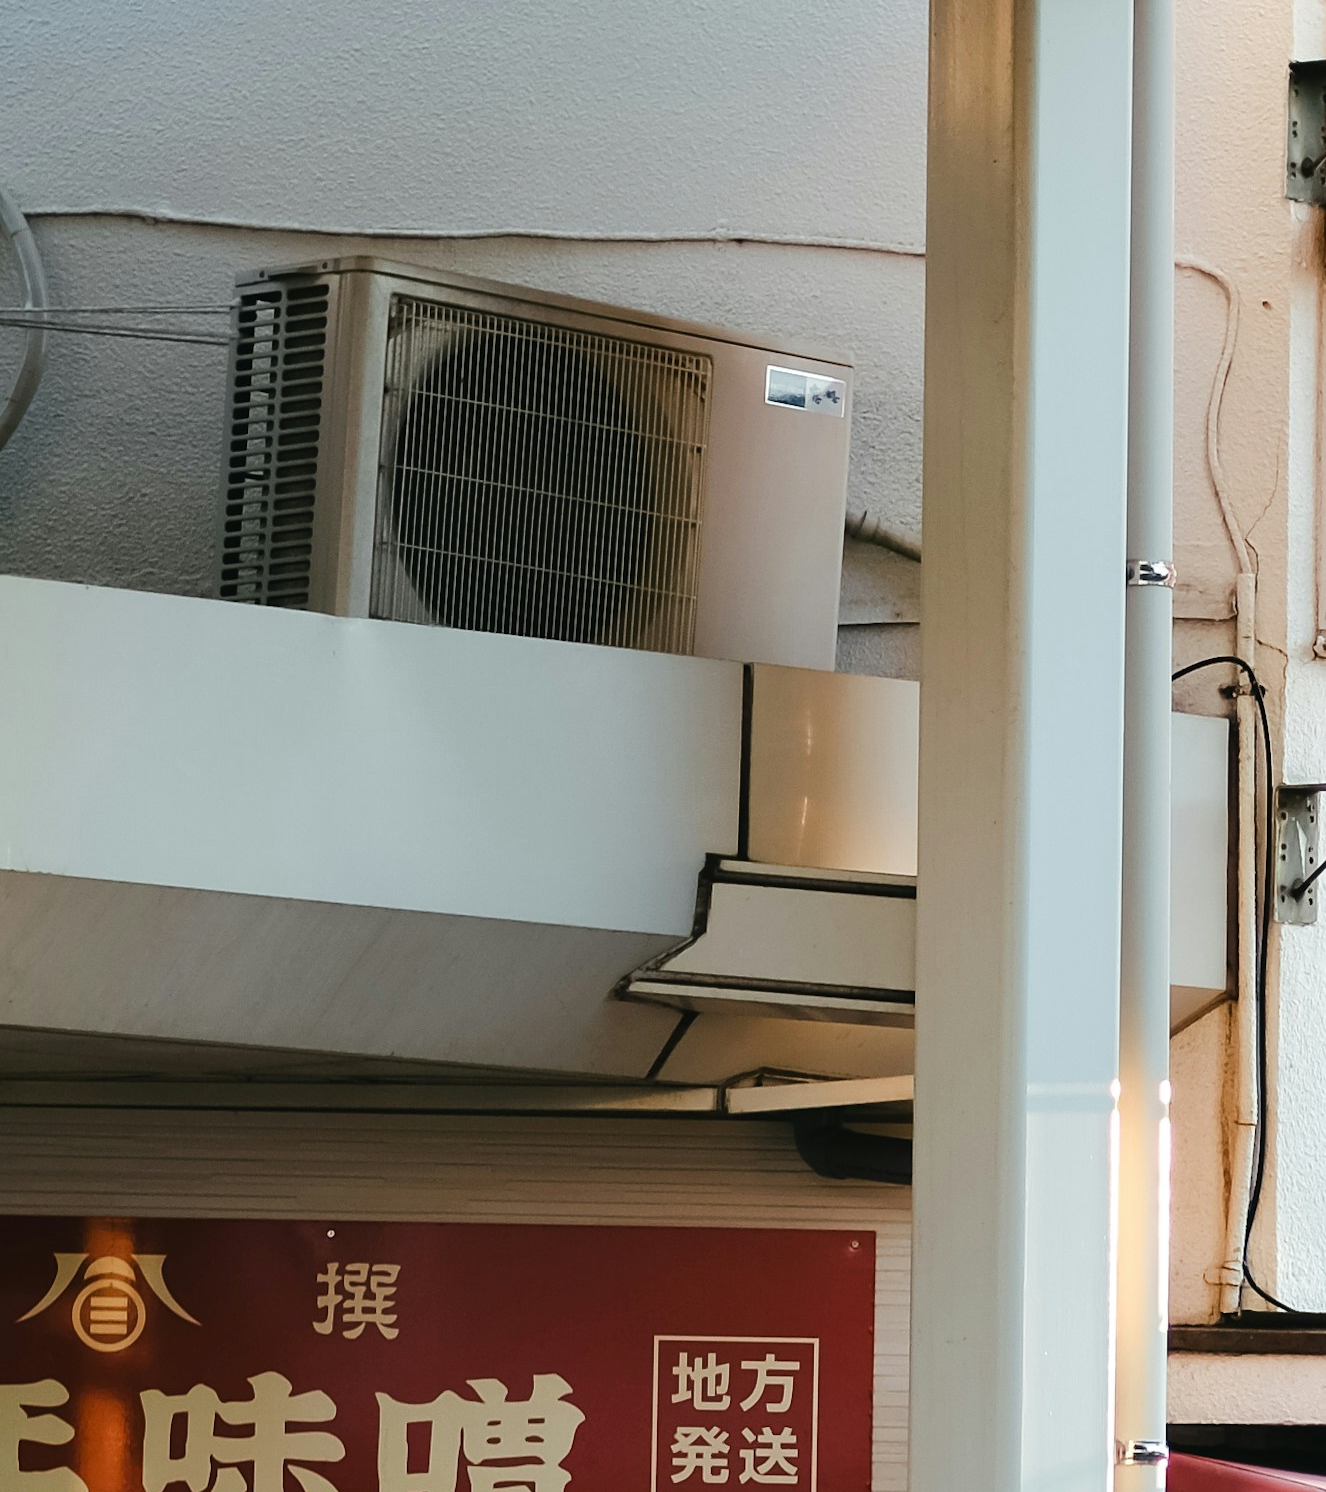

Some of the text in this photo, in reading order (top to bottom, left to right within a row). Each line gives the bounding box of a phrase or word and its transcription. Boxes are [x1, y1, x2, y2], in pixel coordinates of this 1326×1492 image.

[313, 1261, 401, 1341] 撰
[670, 1351, 802, 1412] 地方
[670, 1426, 801, 1487] 発送
